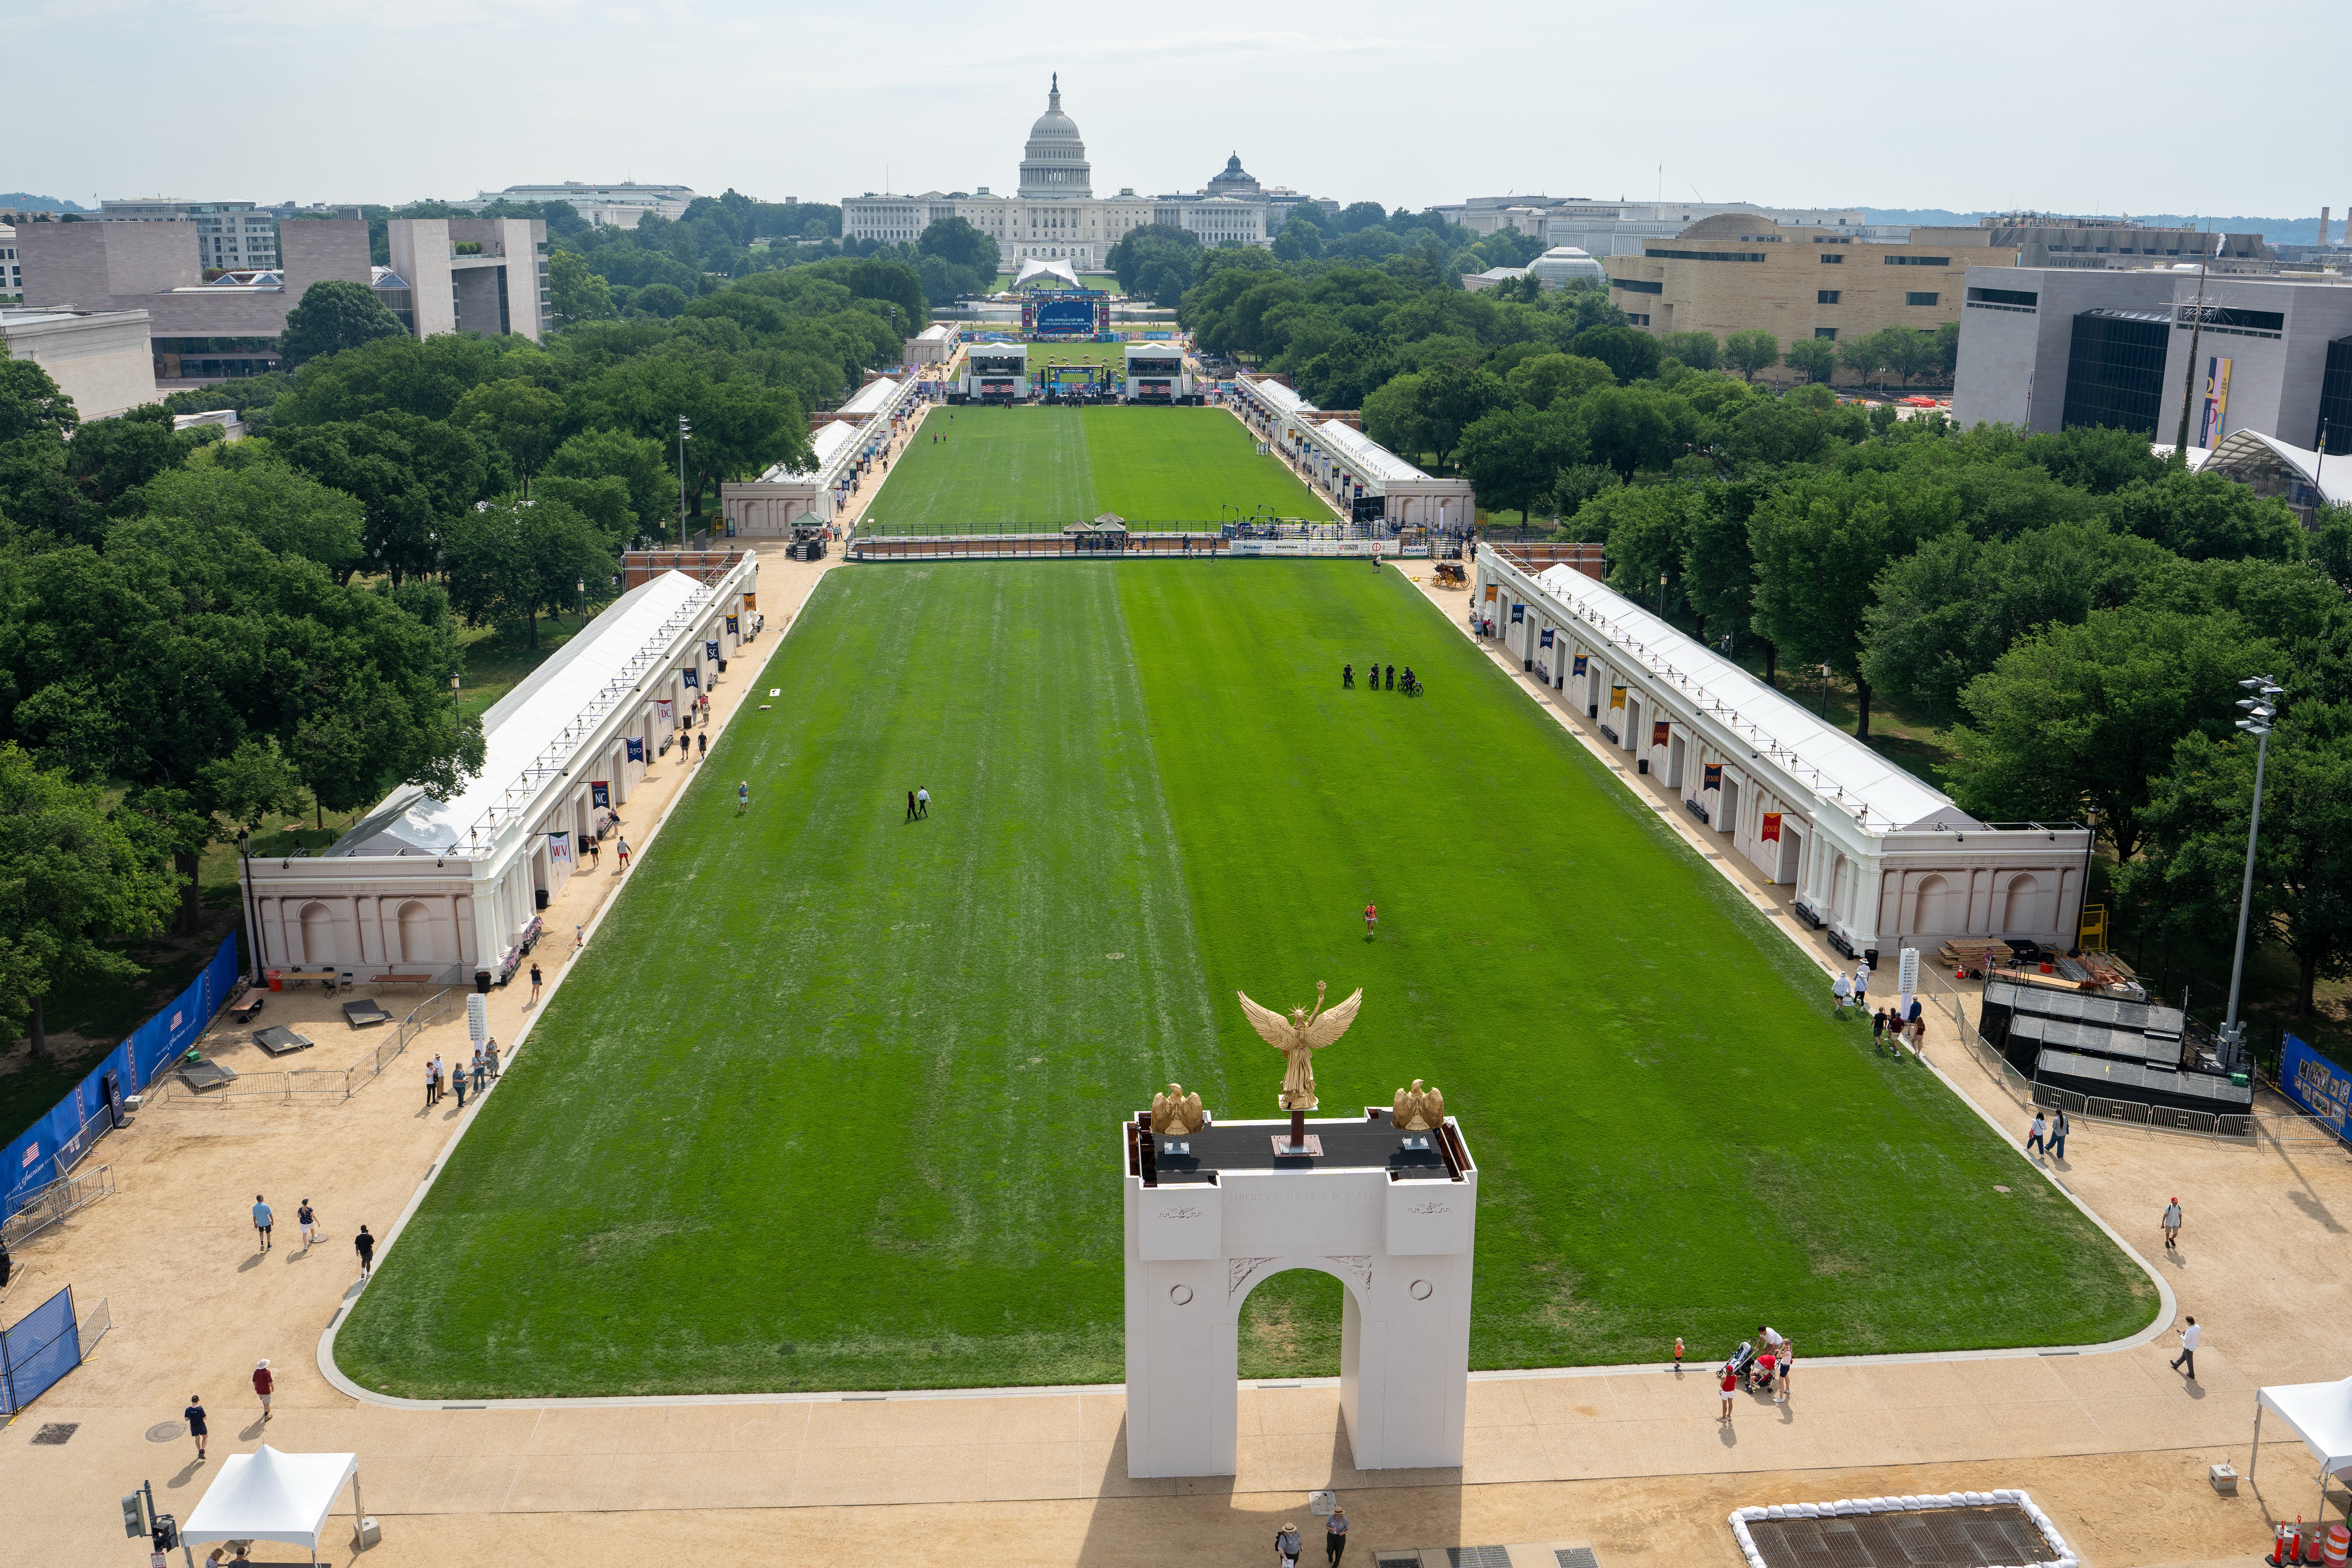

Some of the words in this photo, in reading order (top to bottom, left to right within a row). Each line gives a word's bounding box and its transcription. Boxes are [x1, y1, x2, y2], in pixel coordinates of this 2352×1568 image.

[661, 709, 671, 718] DC
[595, 793, 606, 804] NC
[552, 845, 567, 857] WV
[168, 1029, 185, 1050] American
[11, 1183, 21, 1194] GREAT
[20, 1163, 44, 1190] American
[1229, 1194, 1272, 1202] LIBERTY
[1275, 1193, 1282, 1201] &
[1286, 1193, 1327, 1201] JUSTICE
[1332, 1192, 1351, 1200] FOR
[1356, 1191, 1375, 1200] ALL
